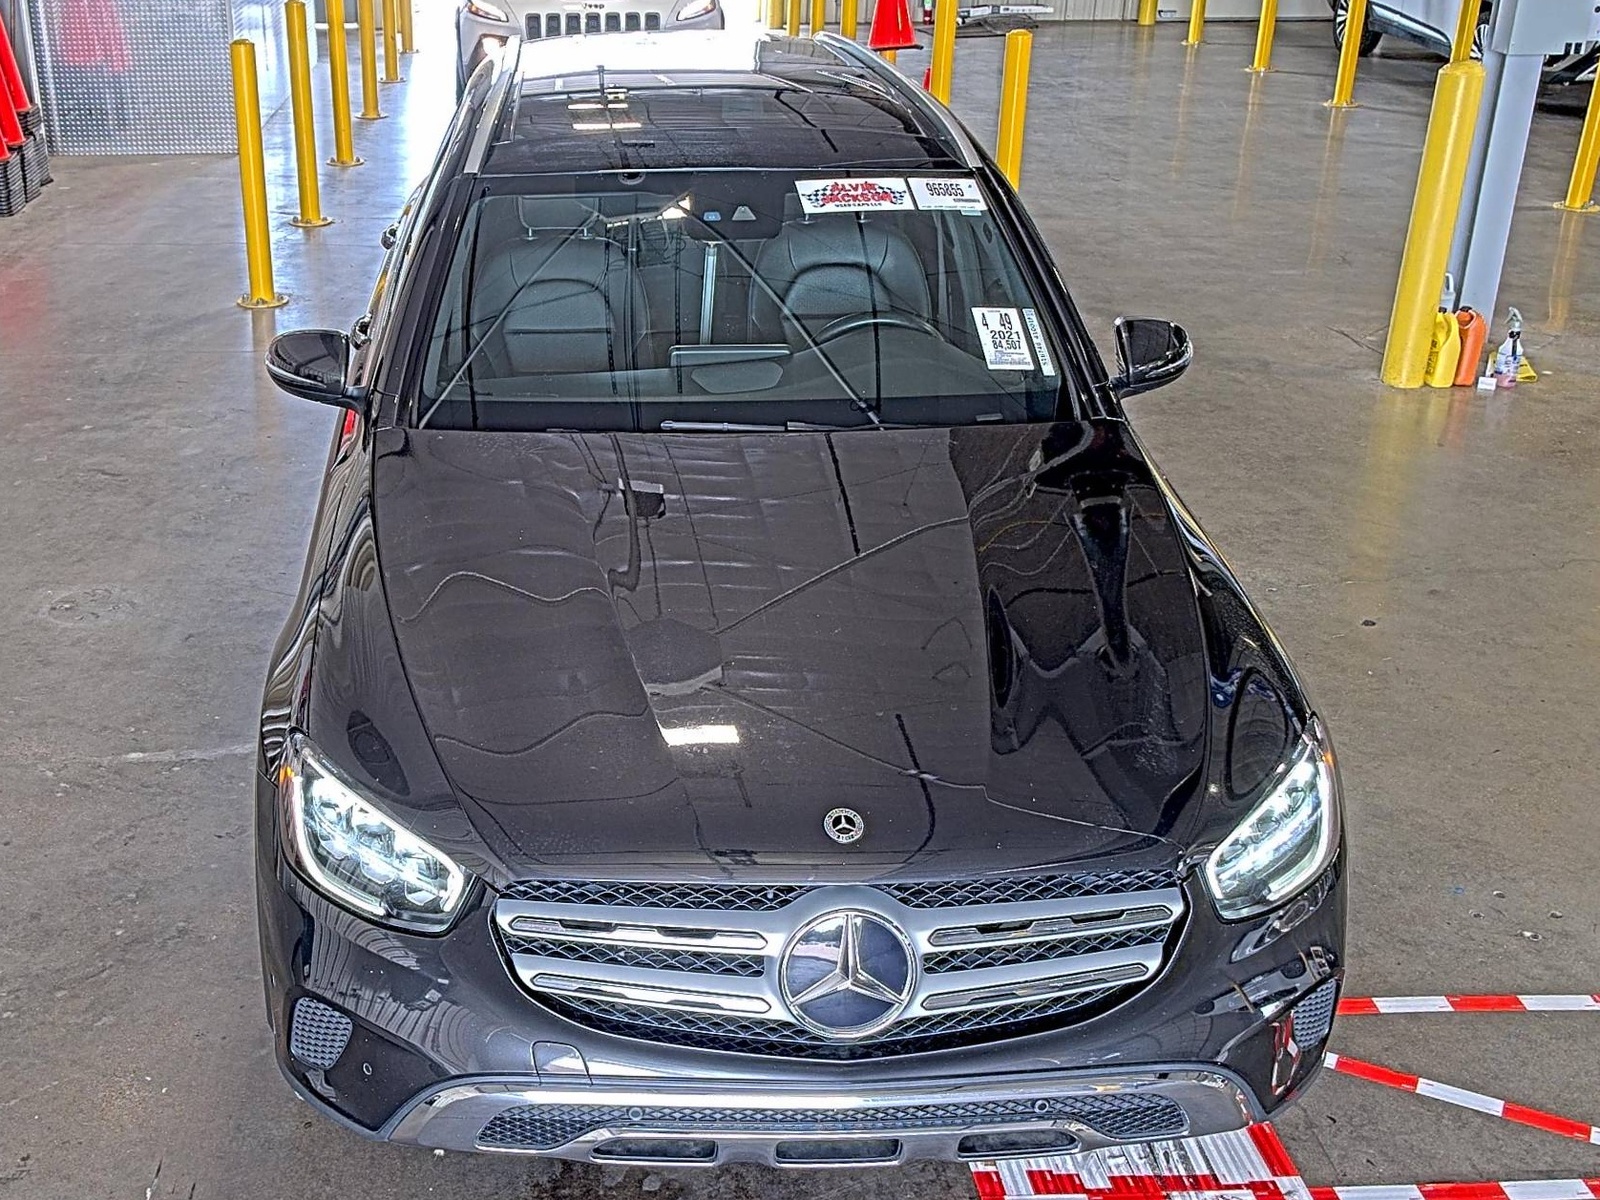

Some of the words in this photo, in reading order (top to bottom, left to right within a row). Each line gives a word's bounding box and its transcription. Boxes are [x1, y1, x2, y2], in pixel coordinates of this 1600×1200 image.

[926, 182, 965, 197] 965855
[982, 312, 989, 330] 4
[999, 312, 1013, 330] 49
[990, 330, 1021, 340] 2021
[992, 340, 1021, 350] 84,507
